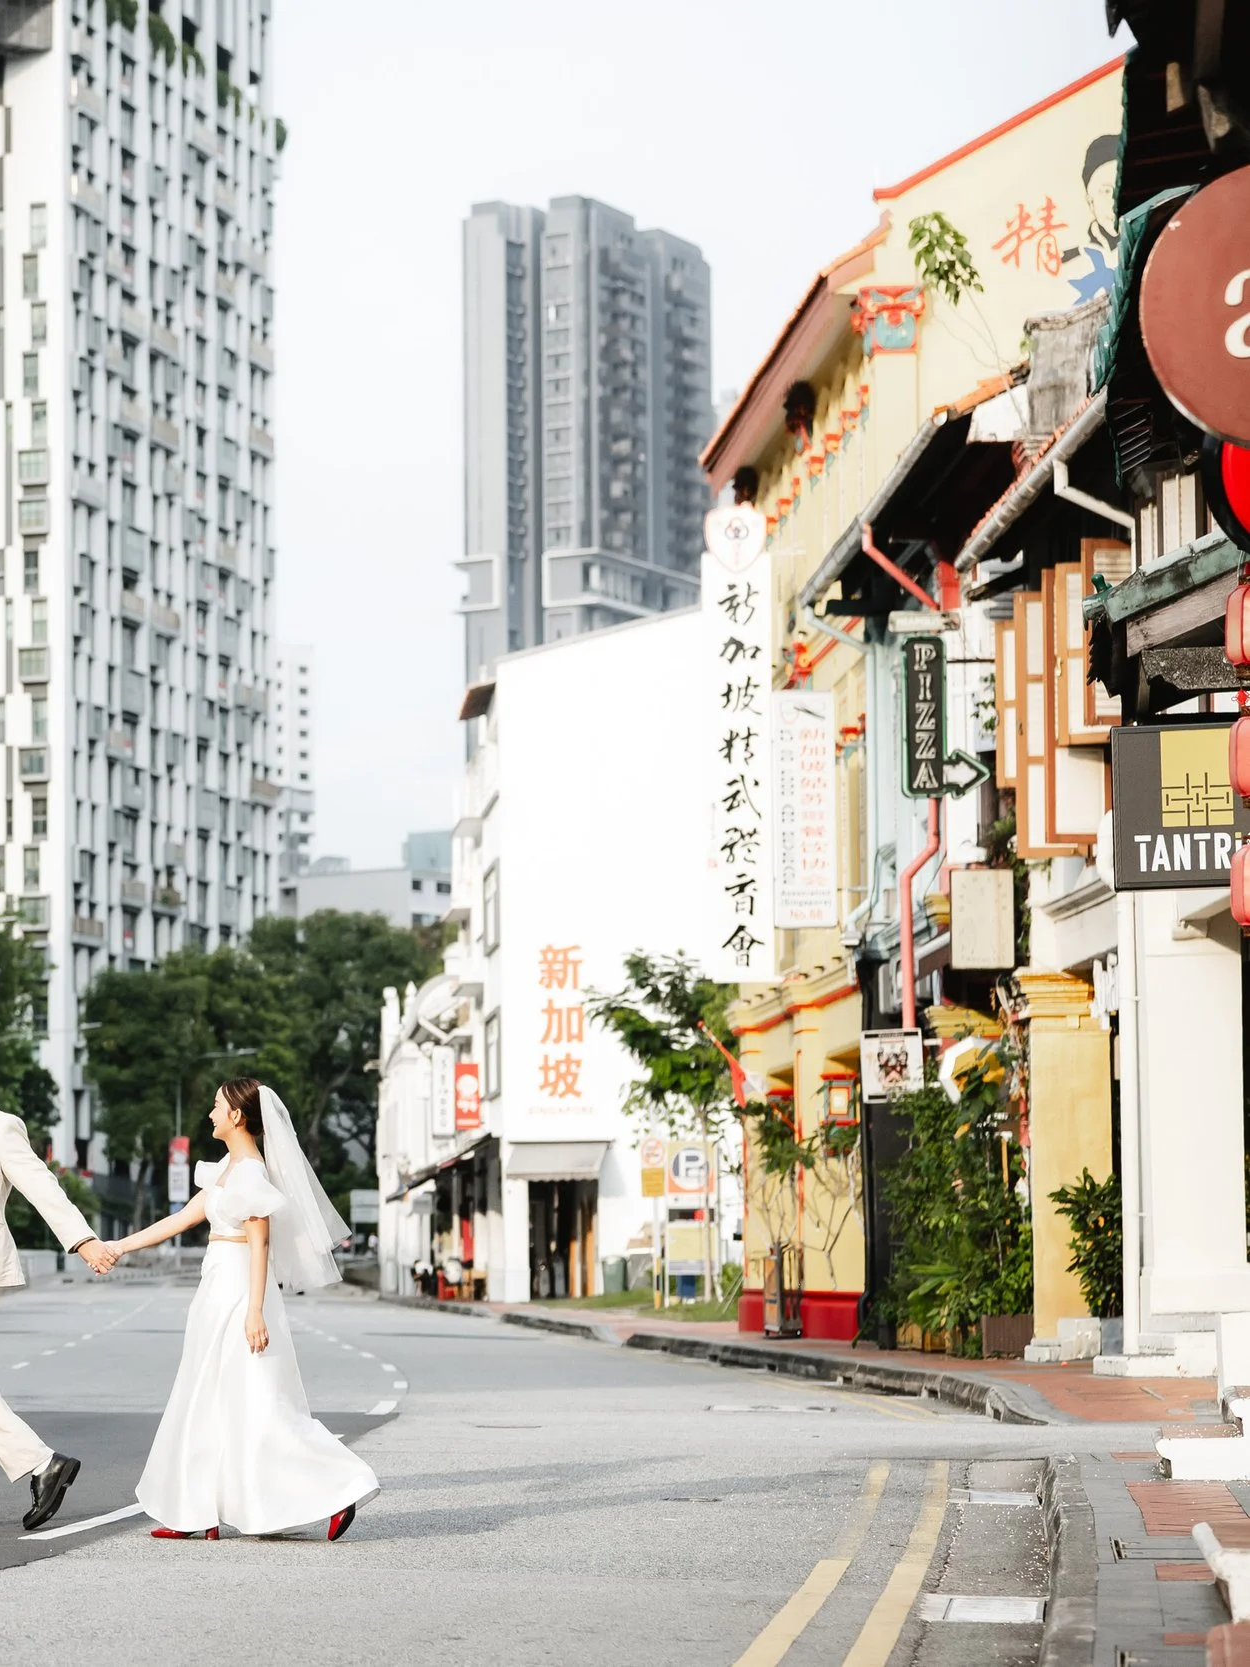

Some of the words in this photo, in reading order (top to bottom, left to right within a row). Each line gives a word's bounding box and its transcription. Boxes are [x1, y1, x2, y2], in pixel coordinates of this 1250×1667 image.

[992, 196, 1068, 277] 精
[912, 643, 939, 789] PIZZA
[1134, 831, 1250, 872] TANTRi
[538, 944, 585, 1099] 新加坡
